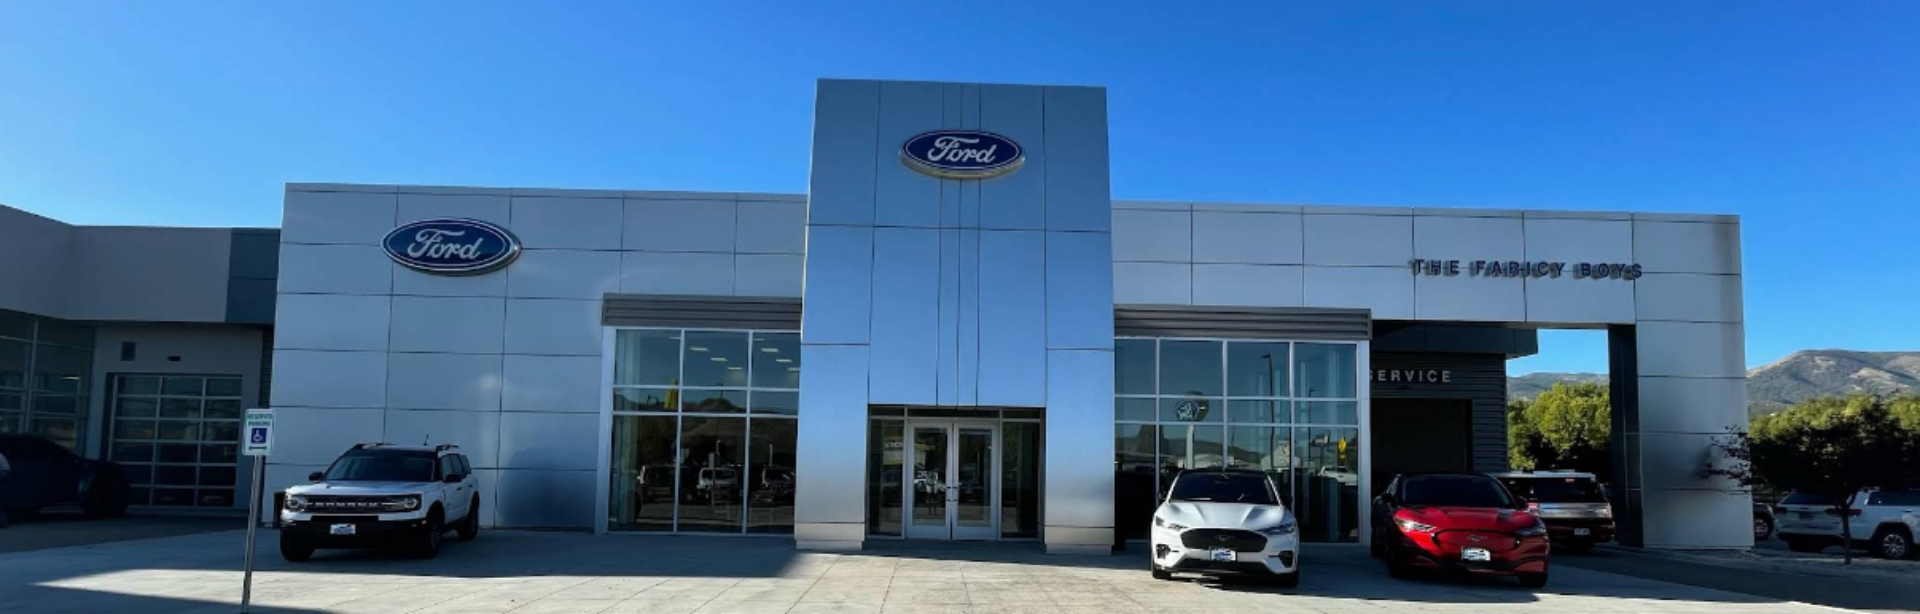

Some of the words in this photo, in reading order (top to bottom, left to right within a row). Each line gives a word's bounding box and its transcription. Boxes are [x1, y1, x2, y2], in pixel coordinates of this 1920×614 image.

[927, 136, 997, 163] Ford
[407, 228, 484, 260] Ford
[1412, 258, 1460, 275] THE
[1474, 260, 1566, 278] FARICY
[1580, 261, 1643, 280] BOYS
